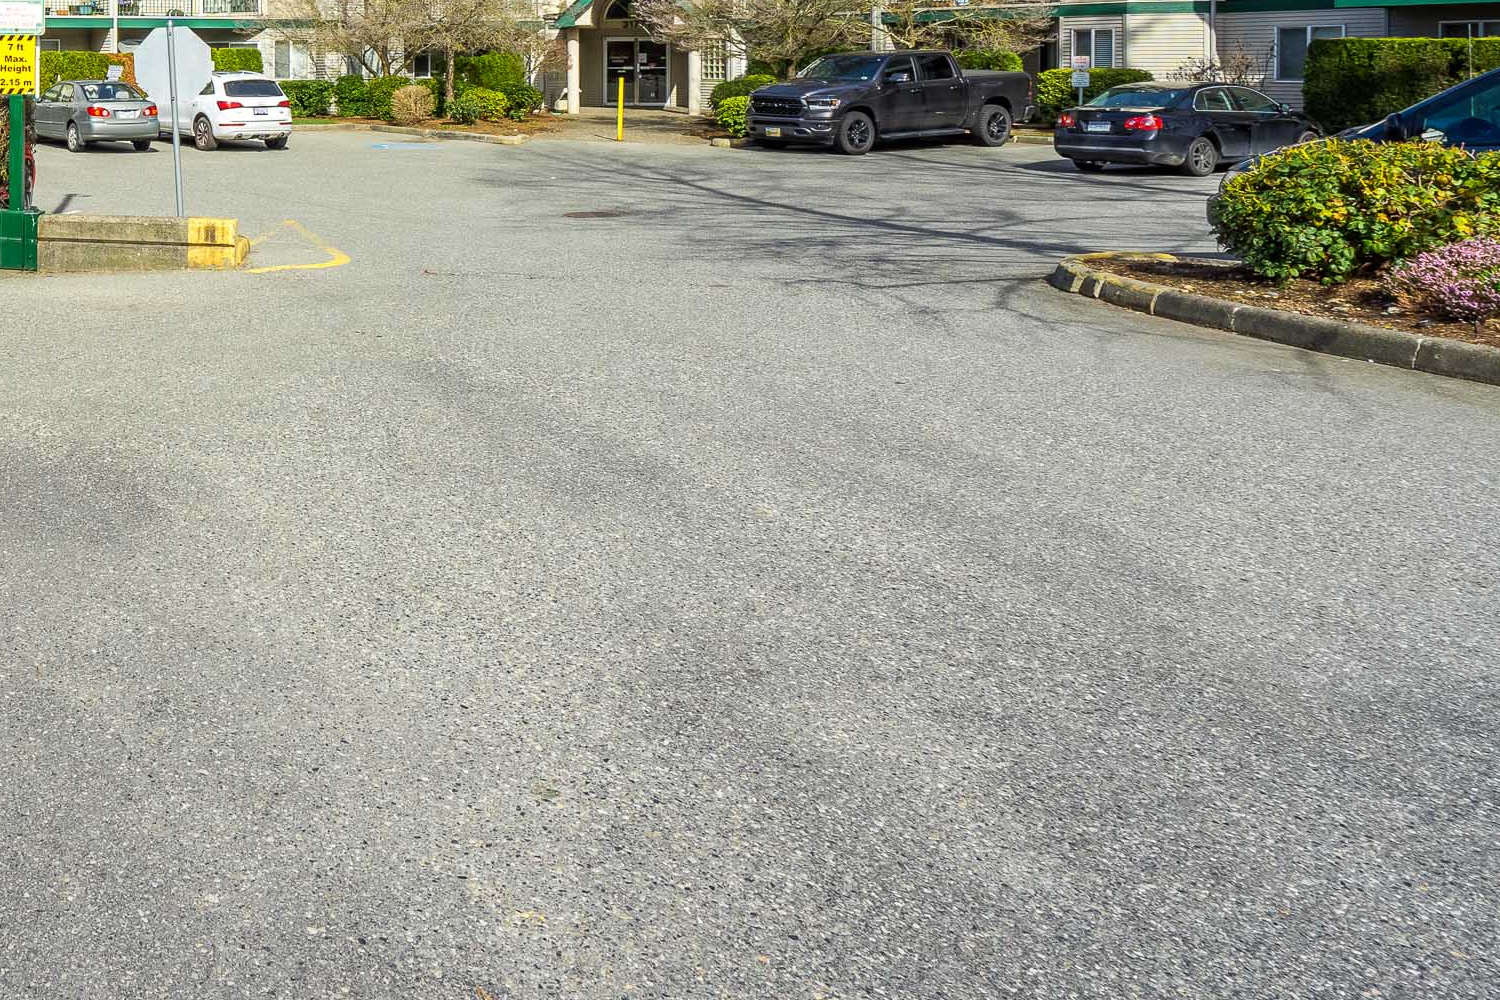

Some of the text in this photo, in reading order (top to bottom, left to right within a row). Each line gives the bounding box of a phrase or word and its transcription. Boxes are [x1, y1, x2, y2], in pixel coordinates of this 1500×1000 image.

[8, 43, 24, 51] 7 ft
[4, 55, 27, 63] Max.
[0, 64, 31, 74] Height
[0, 78, 20, 86] 2.15
